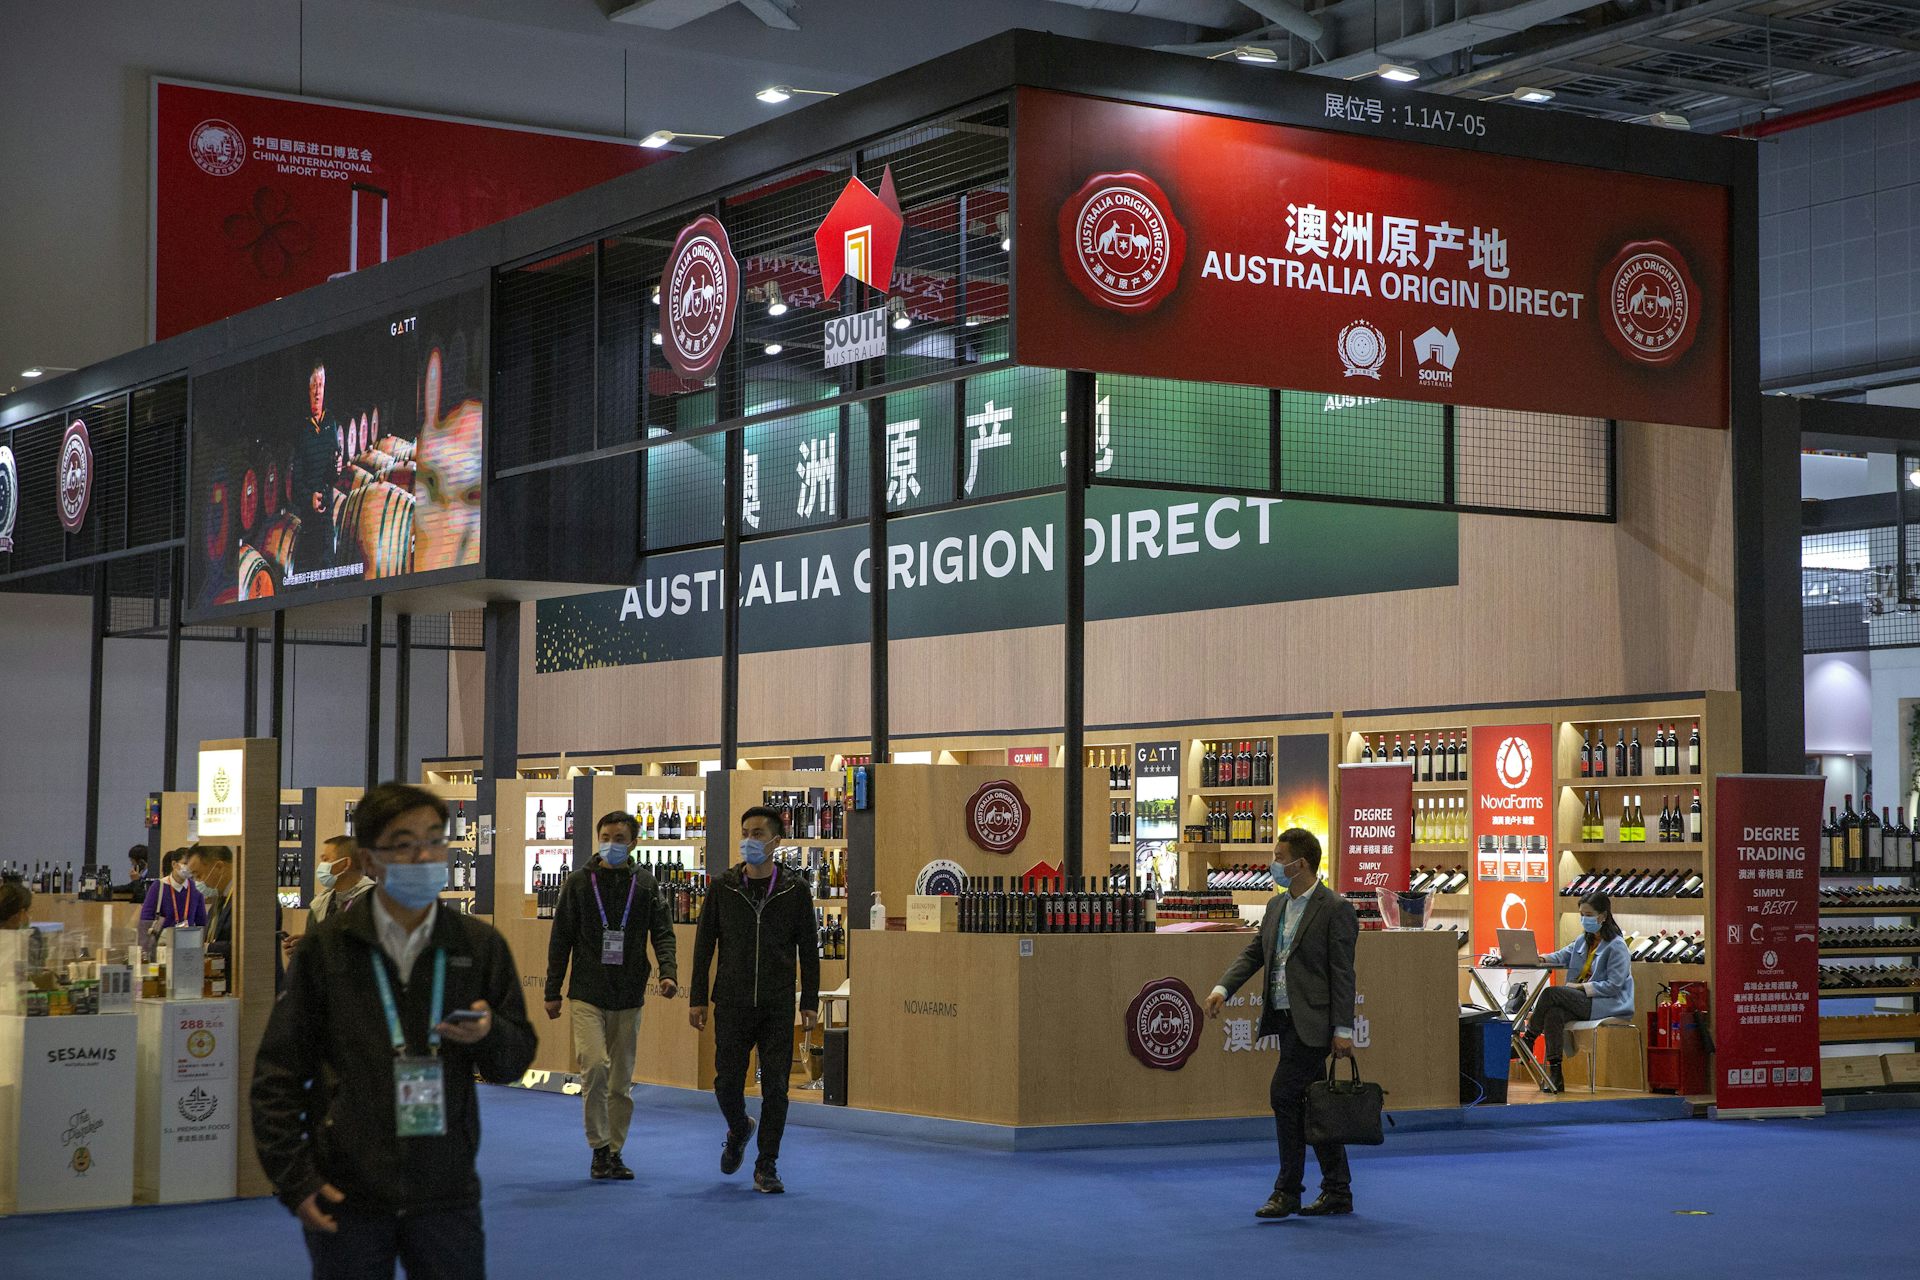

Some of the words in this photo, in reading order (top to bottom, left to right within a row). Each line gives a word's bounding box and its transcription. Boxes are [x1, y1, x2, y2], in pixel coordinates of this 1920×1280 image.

[1403, 105, 1486, 137] 1.1A7-05
[252, 136, 372, 161] 中国国际进口博览会
[252, 150, 287, 163] CHINA
[289, 155, 373, 174] INTERNATIONAL
[277, 164, 317, 177] IMPORT
[320, 169, 349, 180] EXPO
[1083, 197, 1115, 254] AUSTRALIA
[1114, 193, 1153, 220] ORIGIN
[1148, 218, 1164, 264] DIRECT
[1284, 202, 1511, 280] 澳洲原产地
[672, 252, 692, 322] AUSTRALIA
[692, 245, 717, 266] ORIGIN
[712, 261, 723, 314] DIRECT
[1201, 250, 1373, 298] AUSTRALIA
[1380, 271, 1480, 309] ORIGIN
[1488, 283, 1585, 320] DIRECT
[1616, 262, 1643, 315] AUSTRALIA
[1643, 260, 1675, 282] ORIGIN
[1670, 281, 1684, 323] DIRECT
[390, 316, 417, 337] GATT
[825, 308, 886, 351] SOUTH
[825, 341, 886, 368] AUSTRALIA
[1418, 369, 1453, 383] SOUTH
[1418, 379, 1453, 389] AUSTRALIA
[1138, 747, 1177, 762] GATT
[977, 793, 995, 825] AUSTRALIA
[994, 792, 1014, 806] ORIGIN
[1010, 802, 1020, 828] DIRECT
[1481, 794, 1544, 810] NovaFarms
[1354, 808, 1393, 821] DEGREE
[1349, 825, 1396, 838] TRADING
[1743, 827, 1800, 841] DEGREE
[1736, 846, 1806, 861] TRADING
[1359, 861, 1382, 871] SIMPLY
[1738, 868, 1756, 880] 澳洲
[1786, 868, 1804, 880] 酒庄
[1364, 872, 1390, 886] BEST!
[1753, 888, 1786, 898] SIMPLY
[1747, 905, 1759, 913] THE
[1761, 900, 1799, 916] BEST!
[904, 999, 958, 1017] NOVAFARMS
[1140, 996, 1161, 1036] AUSTRALIA
[1159, 993, 1183, 1008] ORIGIN
[1179, 1004, 1191, 1036] DIRECT
[47, 1047, 117, 1063] SESAMIS
